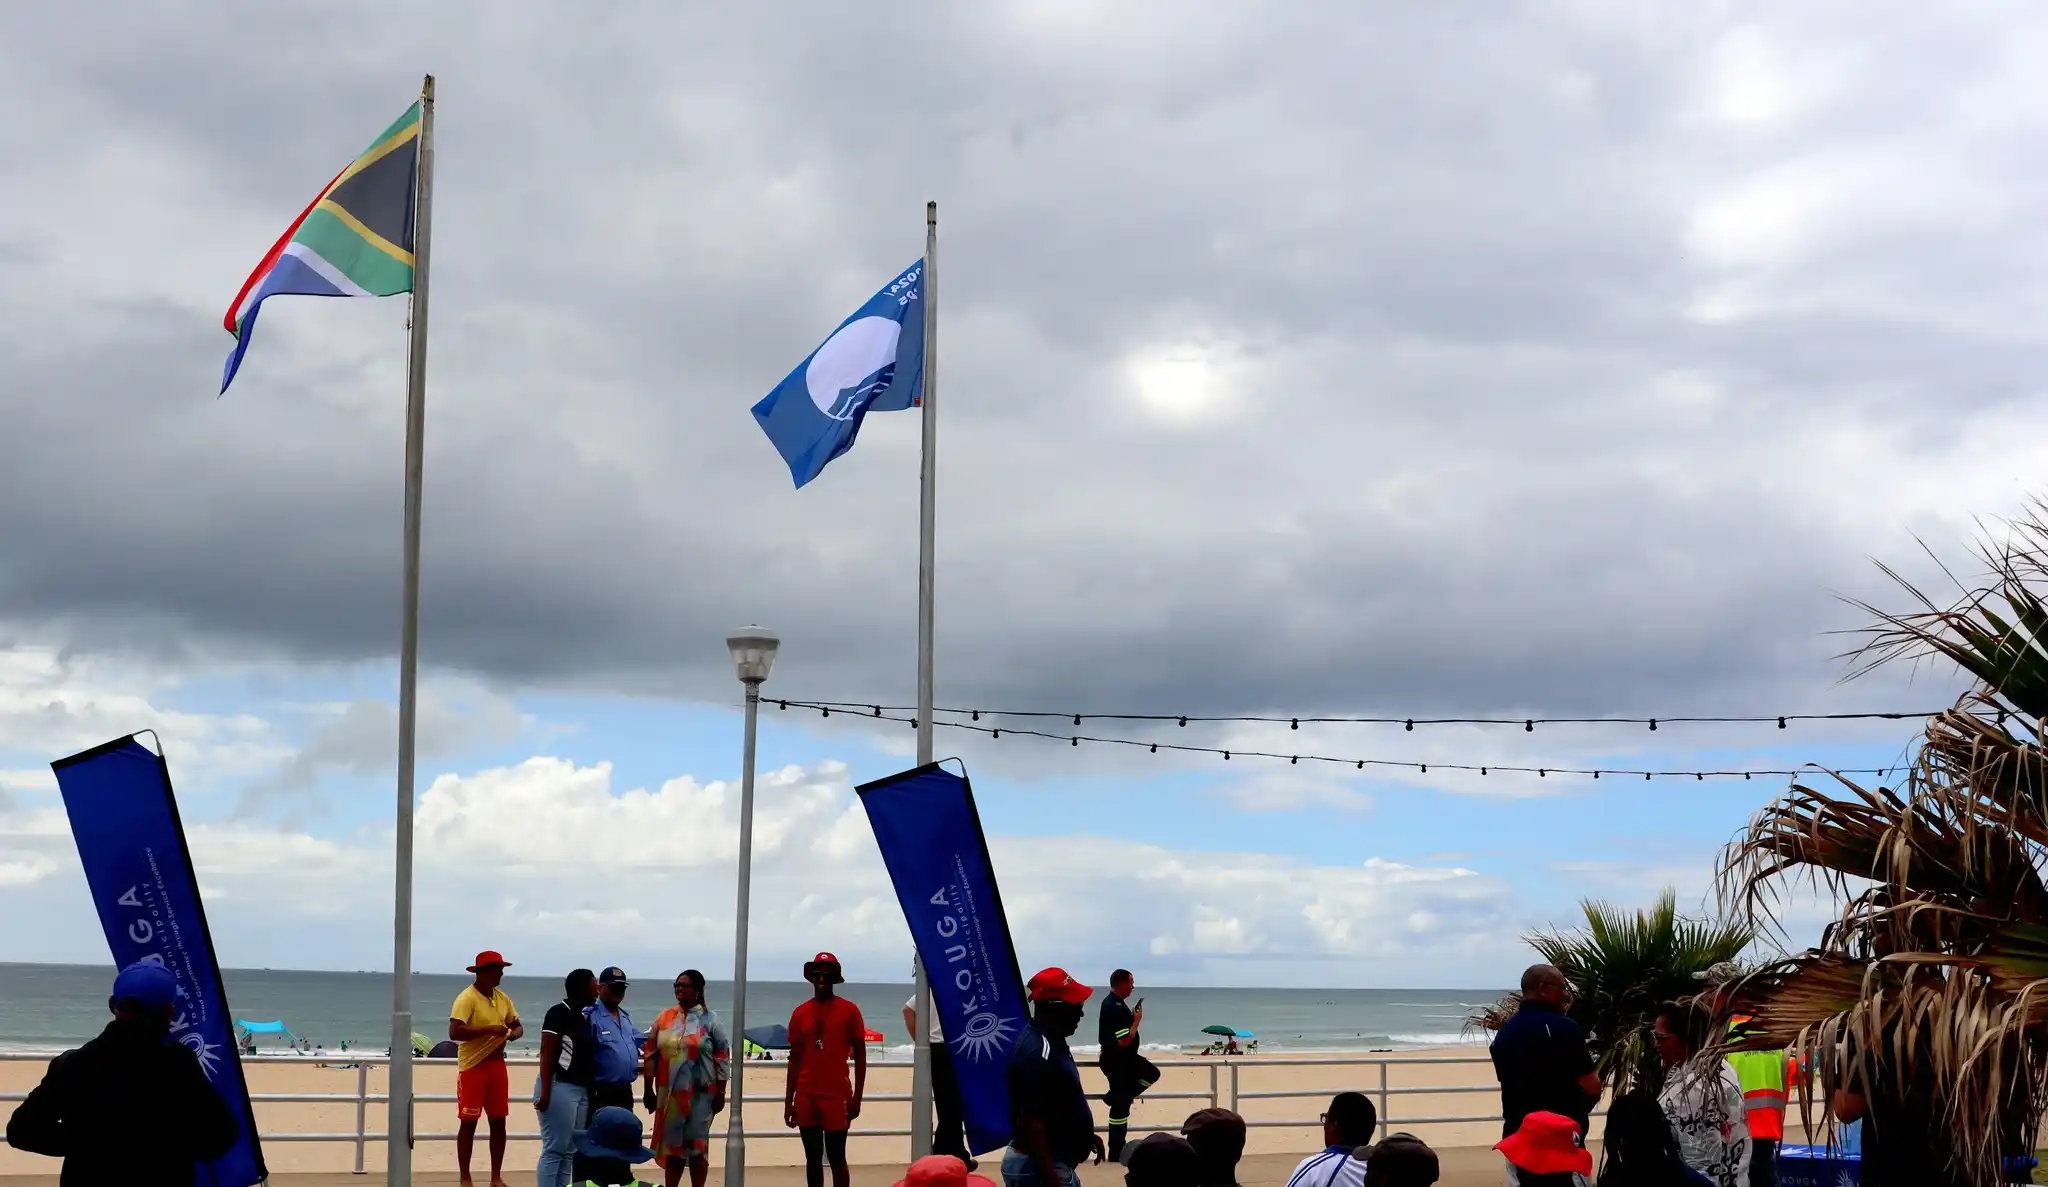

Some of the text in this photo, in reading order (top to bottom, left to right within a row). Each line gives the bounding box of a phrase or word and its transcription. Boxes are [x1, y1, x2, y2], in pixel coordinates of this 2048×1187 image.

[117, 884, 190, 1033] KUGA
[142, 883, 183, 979] municipality
[929, 886, 978, 1015] KOUGA
[949, 884, 988, 1007] local municipality
[1782, 1176, 1818, 1185] KOUGA
